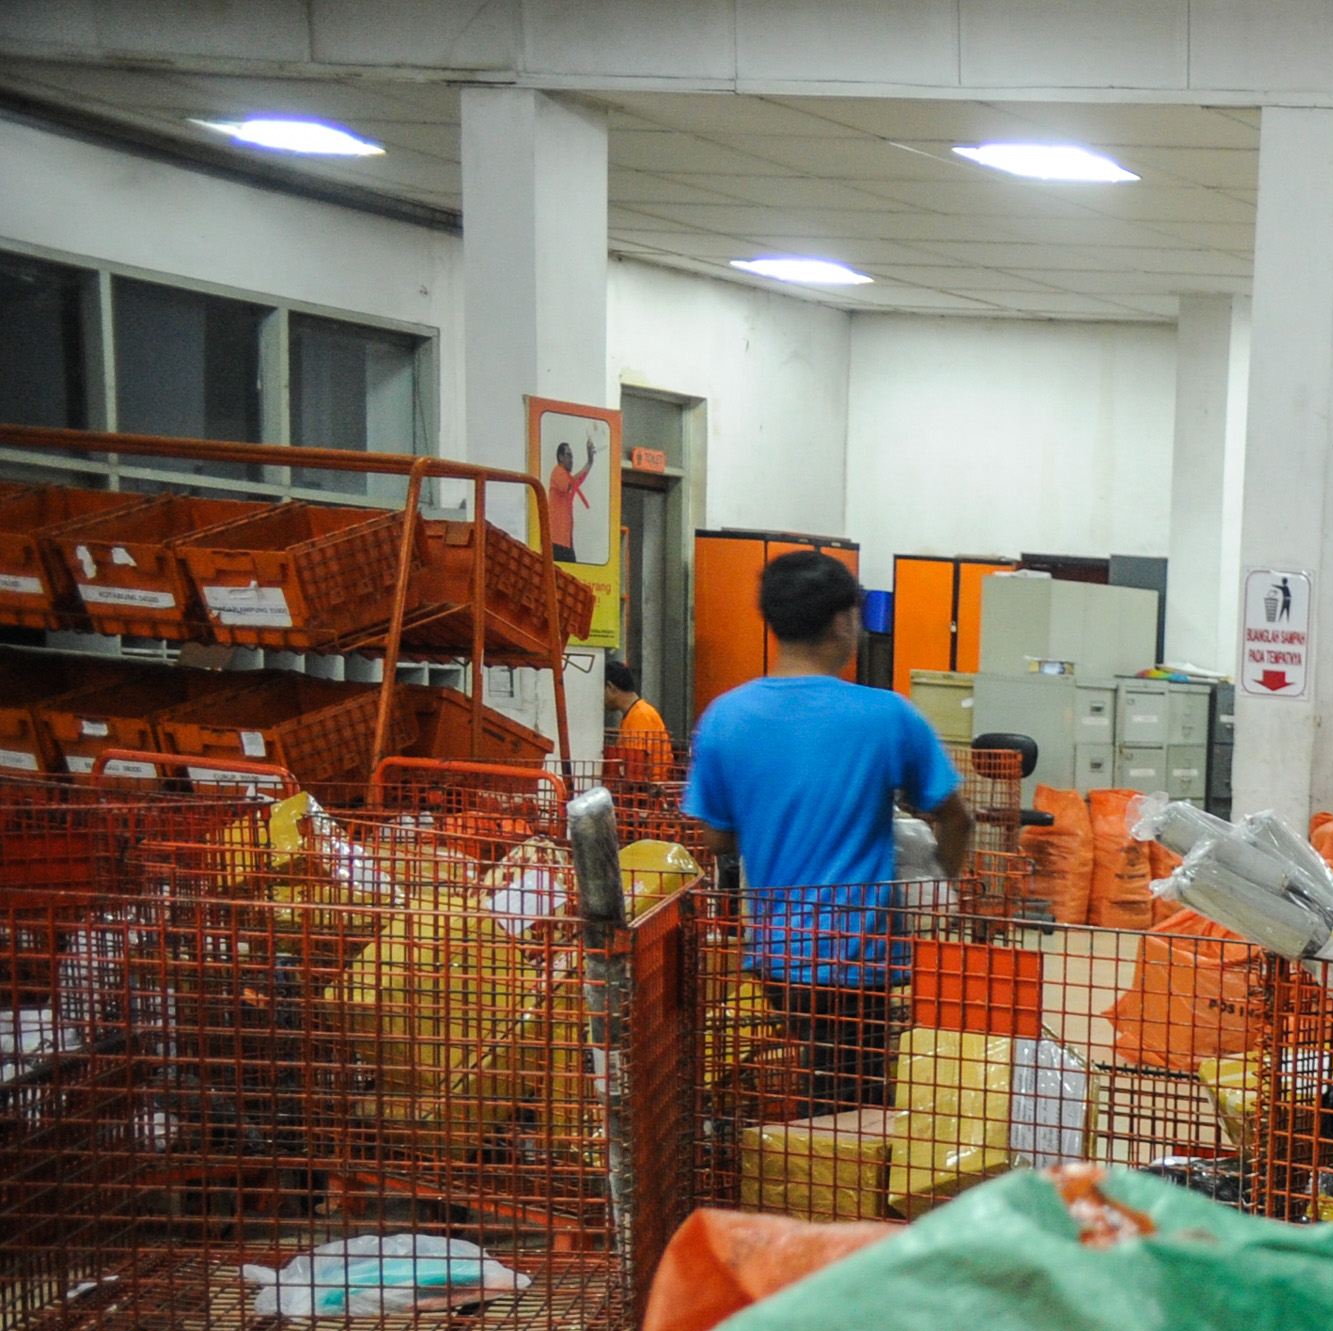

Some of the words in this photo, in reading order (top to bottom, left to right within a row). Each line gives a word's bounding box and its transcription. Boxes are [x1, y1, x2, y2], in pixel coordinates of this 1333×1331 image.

[1246, 628, 1280, 643] BUANGLAH
[1281, 630, 1306, 645] SAMPAH
[1248, 649, 1265, 663] PADA
[1266, 650, 1303, 666] TEMPATNYA
